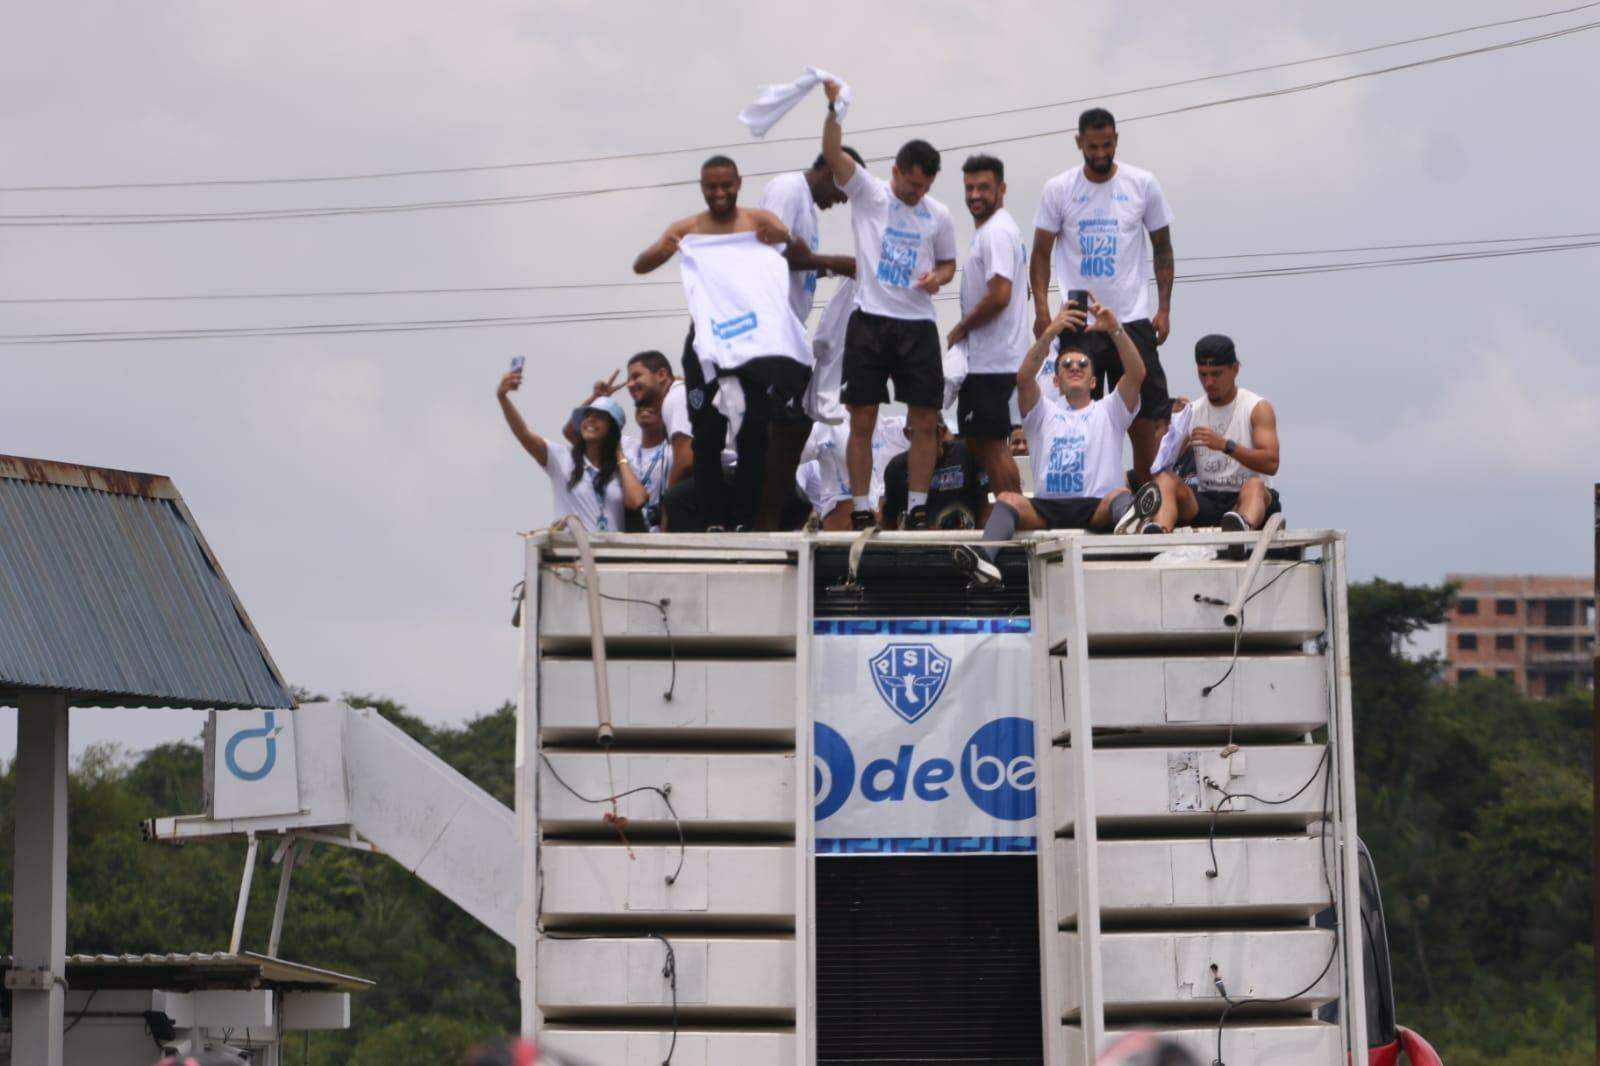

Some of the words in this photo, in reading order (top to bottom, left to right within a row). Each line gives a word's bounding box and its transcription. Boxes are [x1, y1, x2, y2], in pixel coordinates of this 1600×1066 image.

[877, 260, 912, 288] MOS
[1081, 256, 1115, 277] MOS
[1046, 472, 1084, 493] MOS
[859, 744, 955, 803] de
